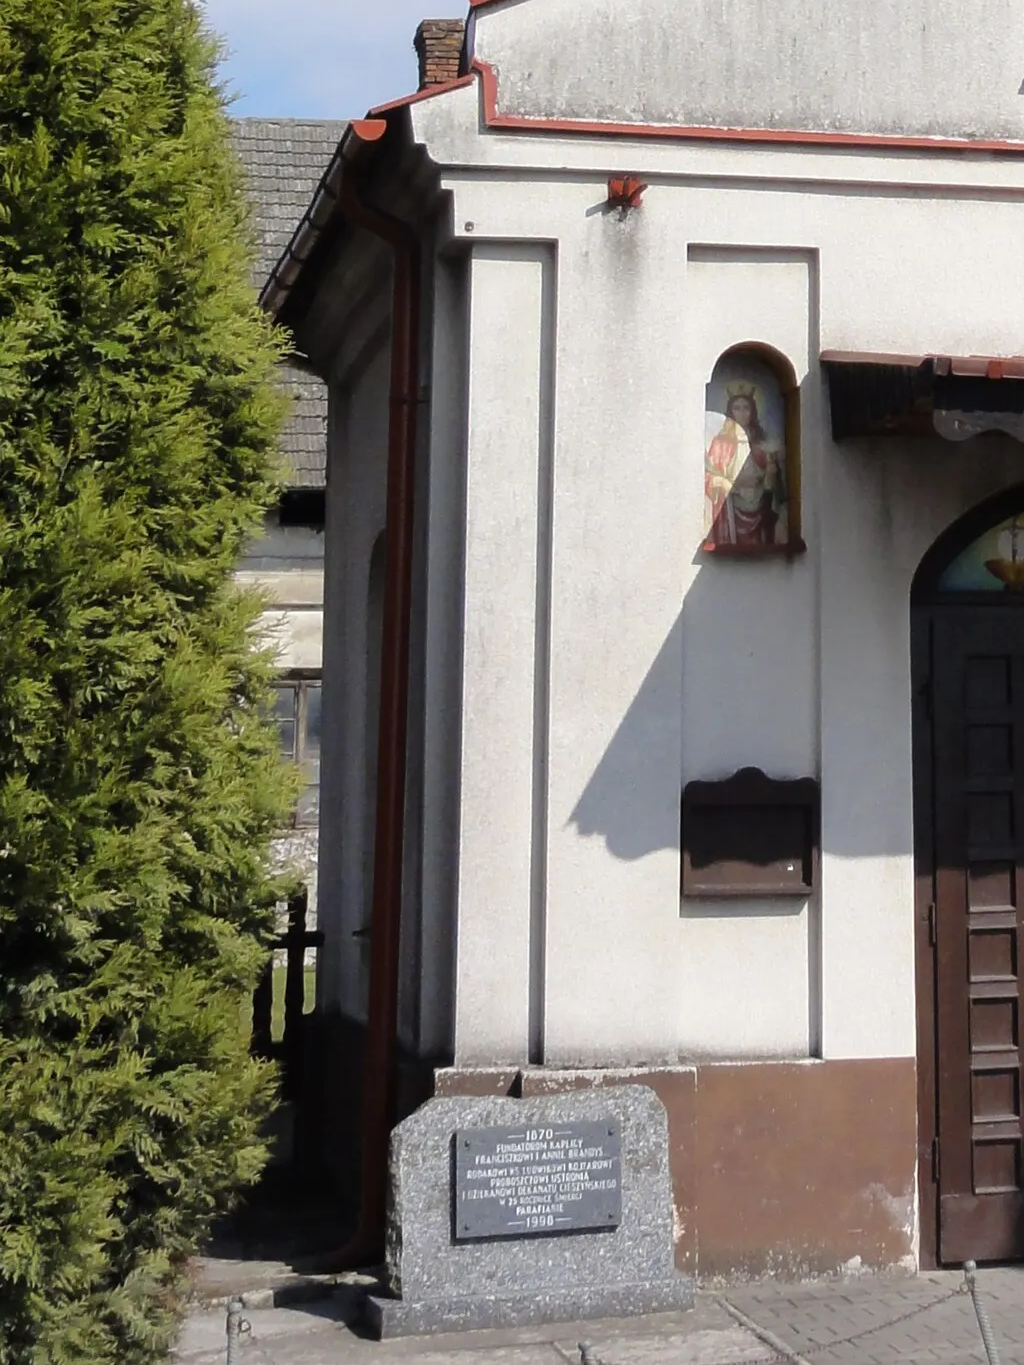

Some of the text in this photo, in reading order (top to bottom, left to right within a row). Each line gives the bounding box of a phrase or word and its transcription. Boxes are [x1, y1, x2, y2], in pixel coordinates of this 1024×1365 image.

[526, 1128, 553, 1141] 1870
[549, 1137, 583, 1150] KAPLICY
[551, 1170, 590, 1183] USTRONIA
[515, 1202, 564, 1216] PARAFIANIE
